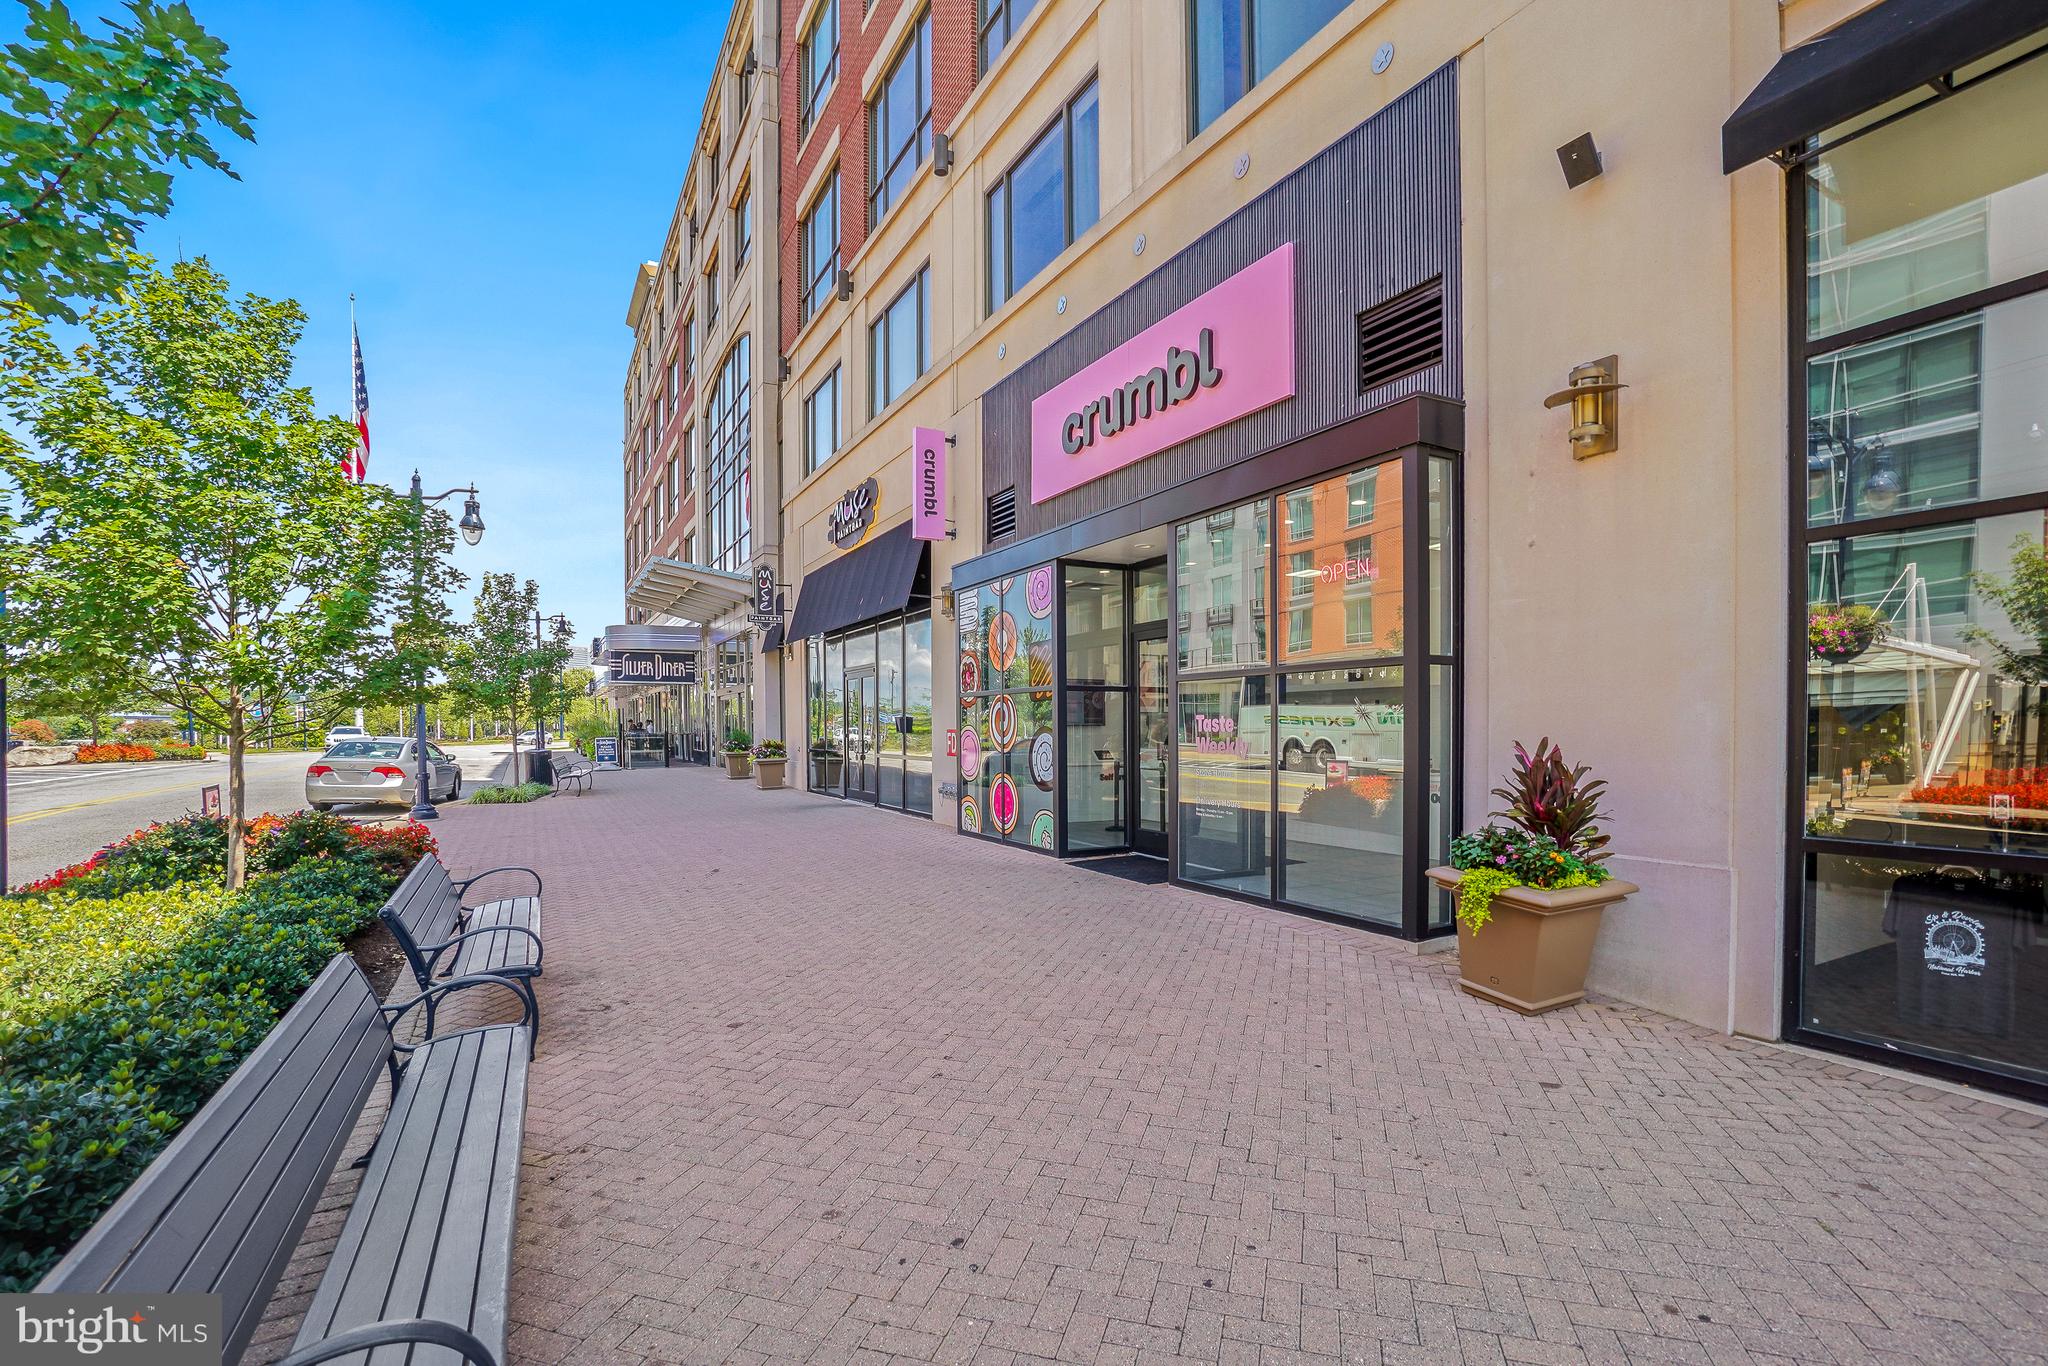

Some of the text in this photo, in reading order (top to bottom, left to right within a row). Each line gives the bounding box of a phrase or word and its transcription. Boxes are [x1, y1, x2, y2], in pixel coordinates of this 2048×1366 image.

[1061, 328, 1223, 455] crumbl
[923, 448, 938, 518] crumbl
[837, 518, 863, 541] PAINTBAR
[1320, 558, 1370, 583] OPEN
[1195, 714, 1234, 733] Taste
[947, 732, 957, 754] FD
[1195, 736, 1249, 760] Weekly
